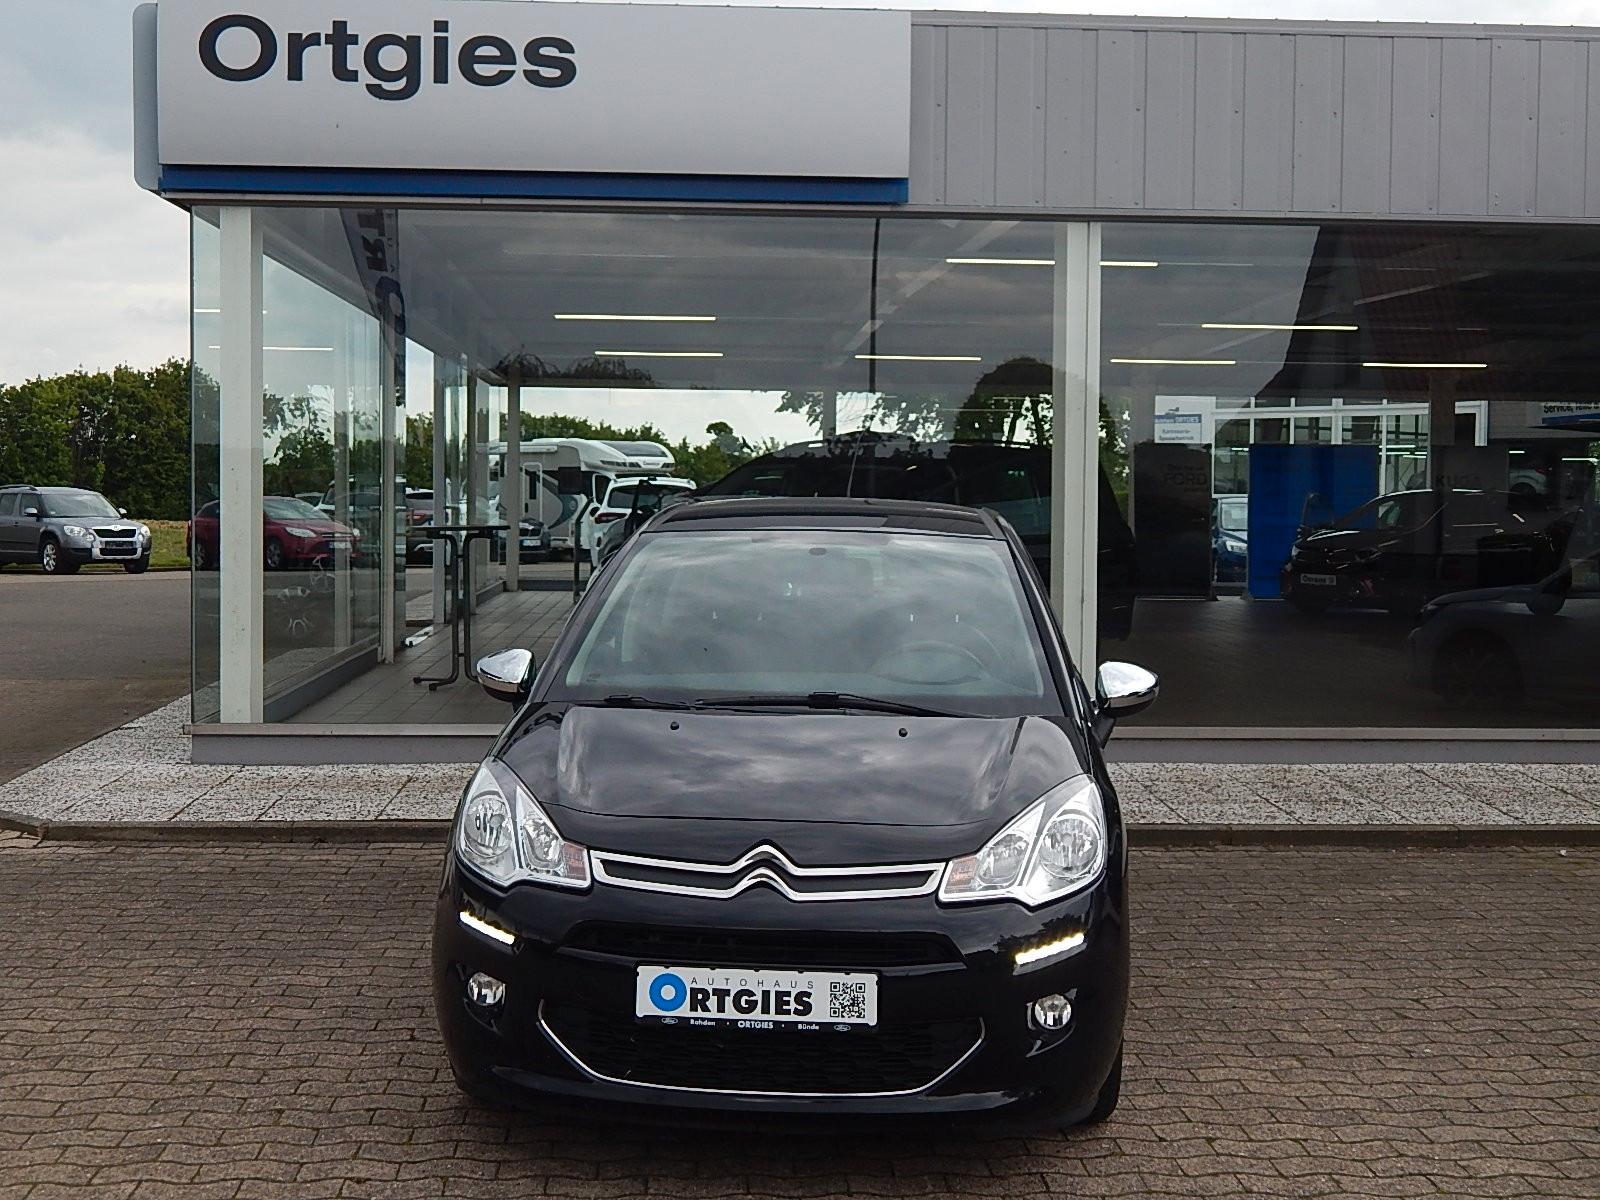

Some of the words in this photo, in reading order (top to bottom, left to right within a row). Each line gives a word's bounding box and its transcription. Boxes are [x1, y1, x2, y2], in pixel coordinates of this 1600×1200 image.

[198, 14, 577, 101] Ortgies
[649, 972, 813, 1016] ORTGIES
[691, 976, 814, 990] AUTOHAUS
[737, 1020, 774, 1030] ORTGIES
